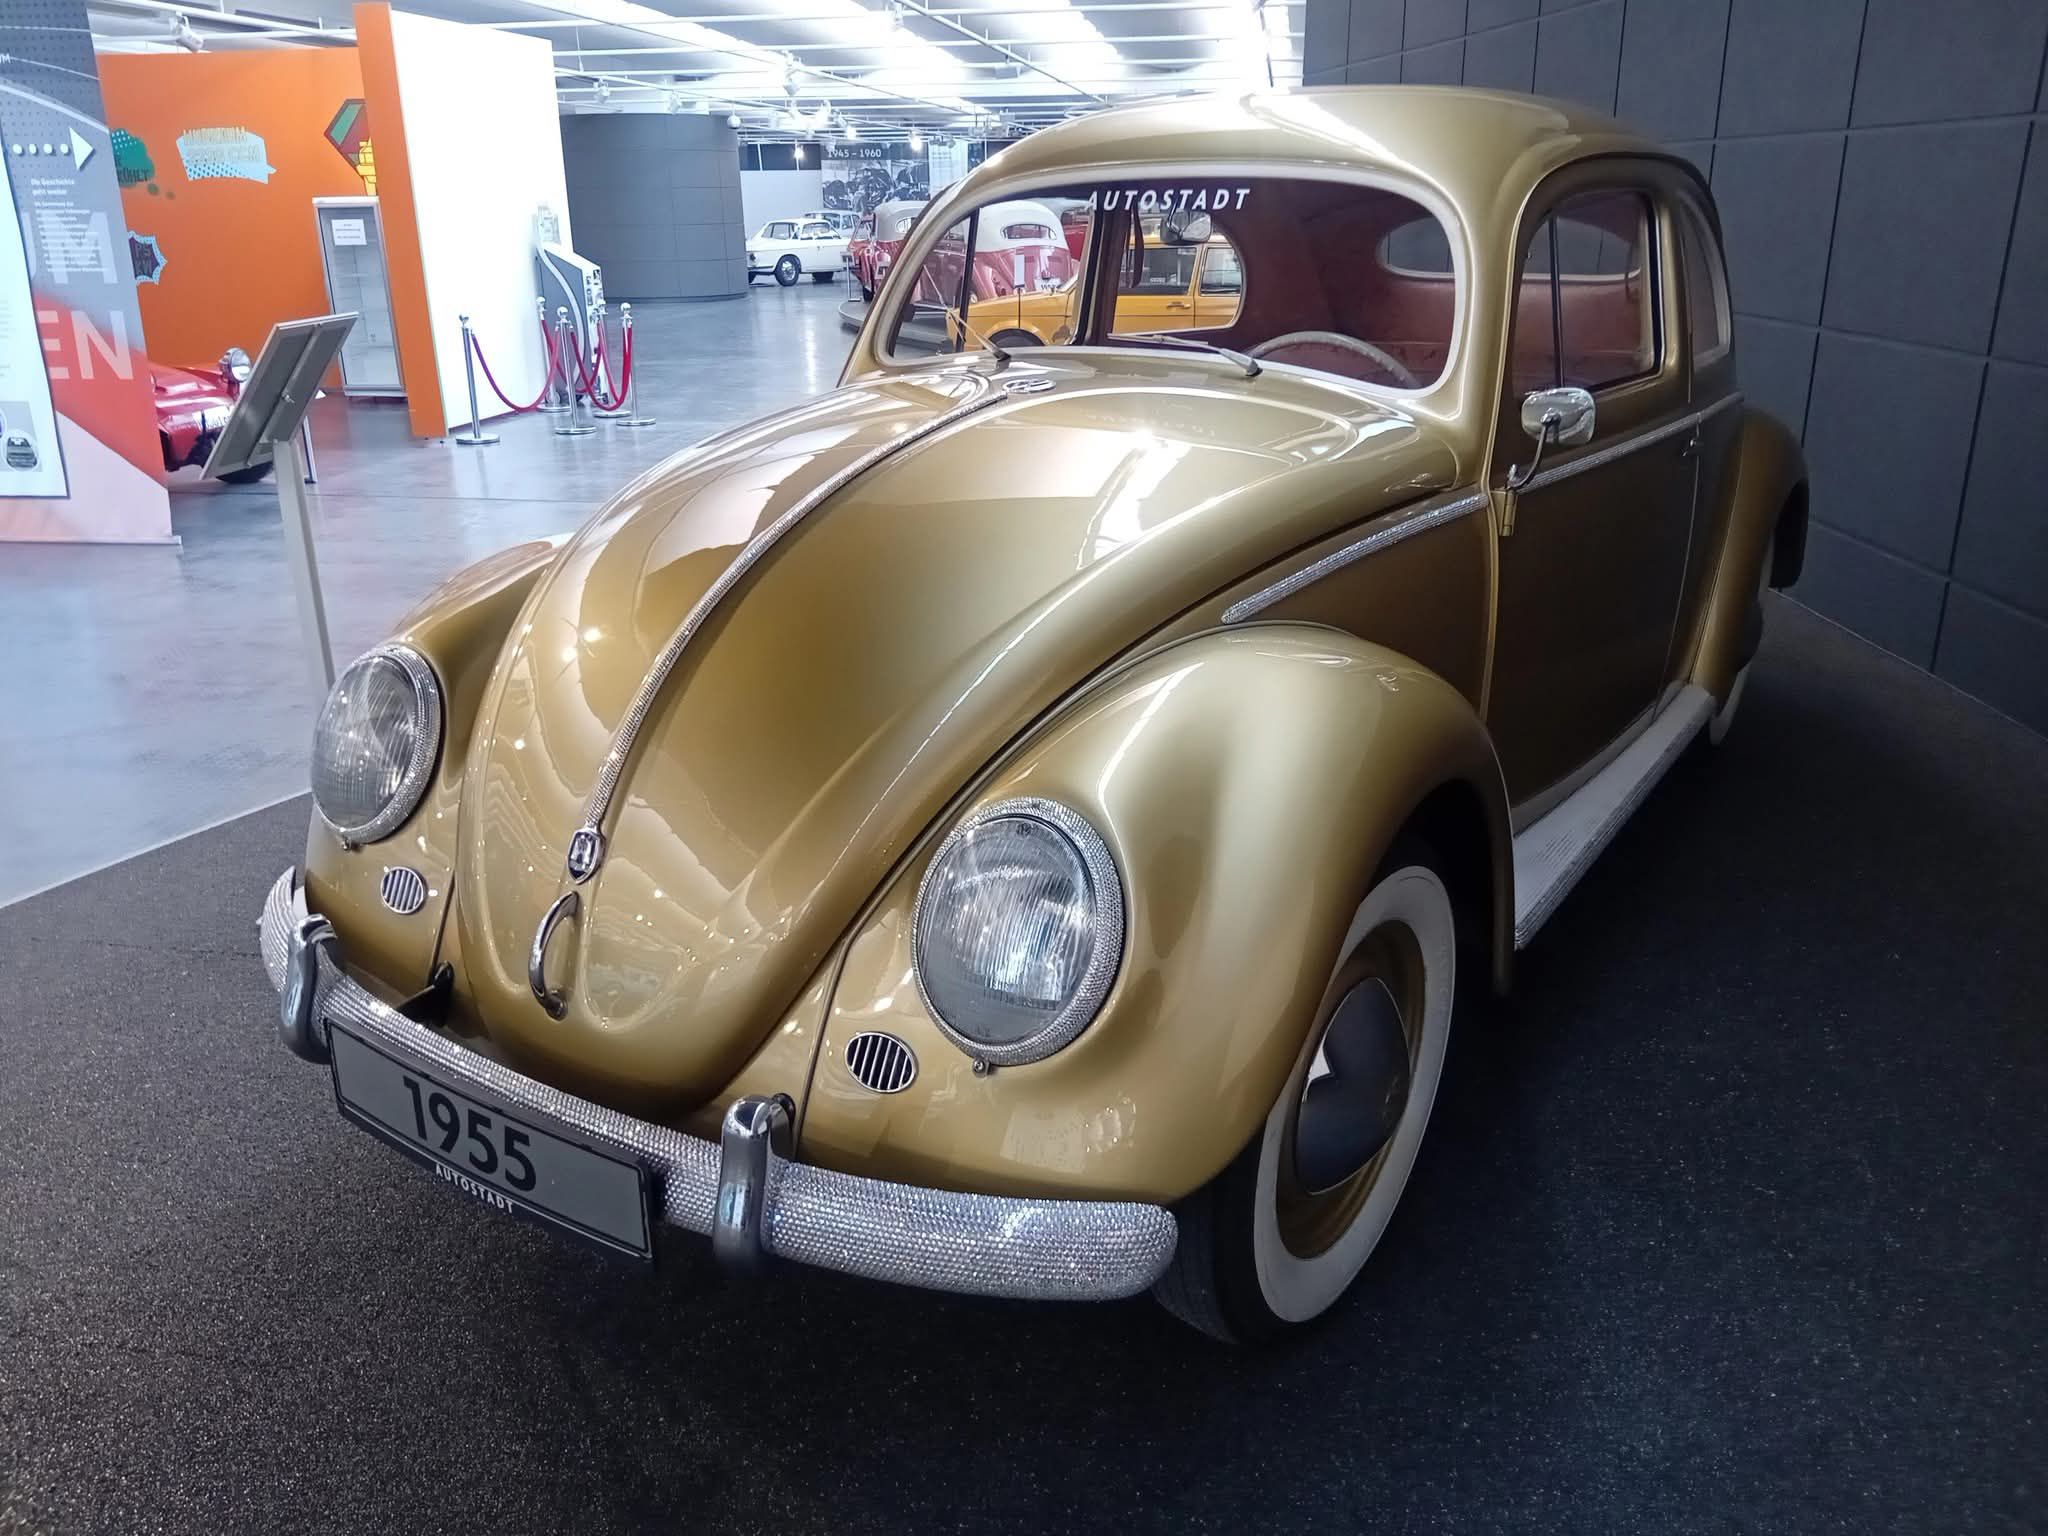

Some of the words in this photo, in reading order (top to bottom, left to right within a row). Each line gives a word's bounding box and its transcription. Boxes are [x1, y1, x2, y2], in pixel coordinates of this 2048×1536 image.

[827, 148, 849, 158] 1945
[860, 148, 882, 158] 1960
[1084, 188, 1250, 211] AUTOSTADT
[403, 1075, 536, 1191] 1955
[435, 1164, 513, 1214] AUTOSTADT
